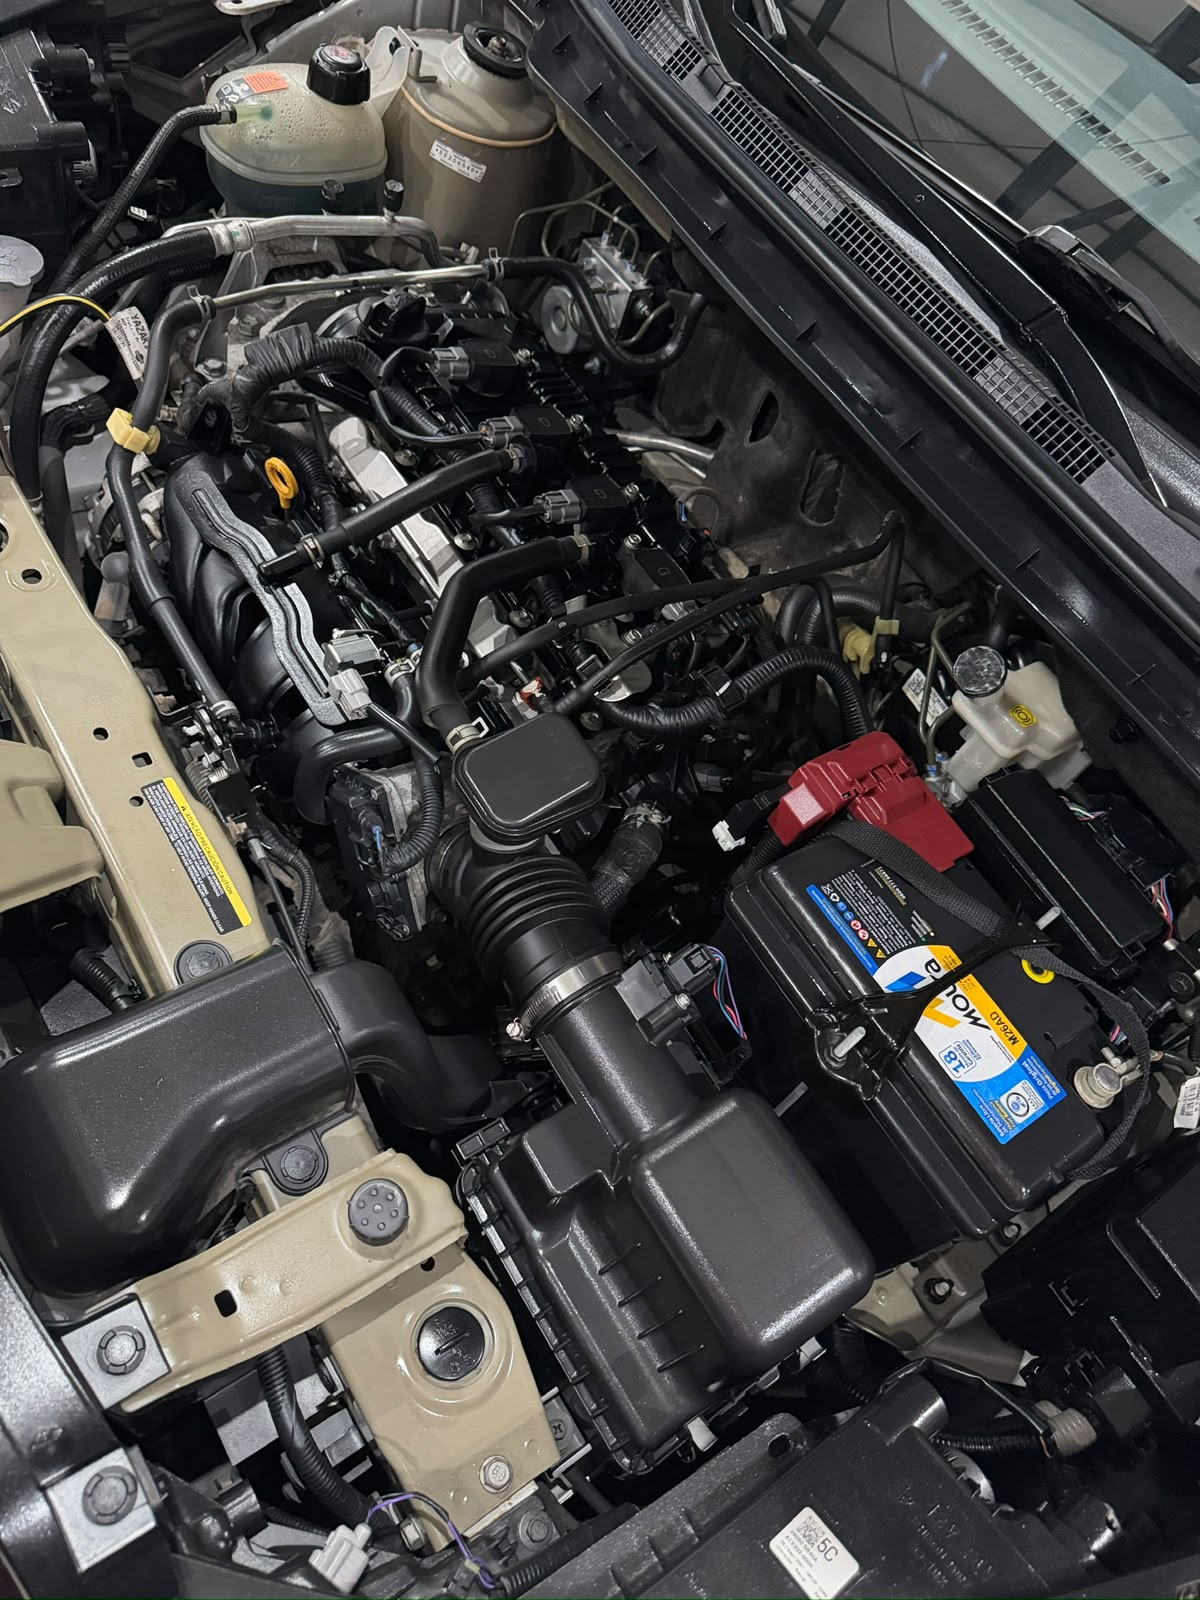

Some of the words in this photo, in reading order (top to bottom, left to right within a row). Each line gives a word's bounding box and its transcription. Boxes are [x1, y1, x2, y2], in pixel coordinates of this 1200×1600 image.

[988, 1008, 1019, 1047] M26AD
[942, 1052, 965, 1074] 18
[817, 1537, 839, 1562] 5C
